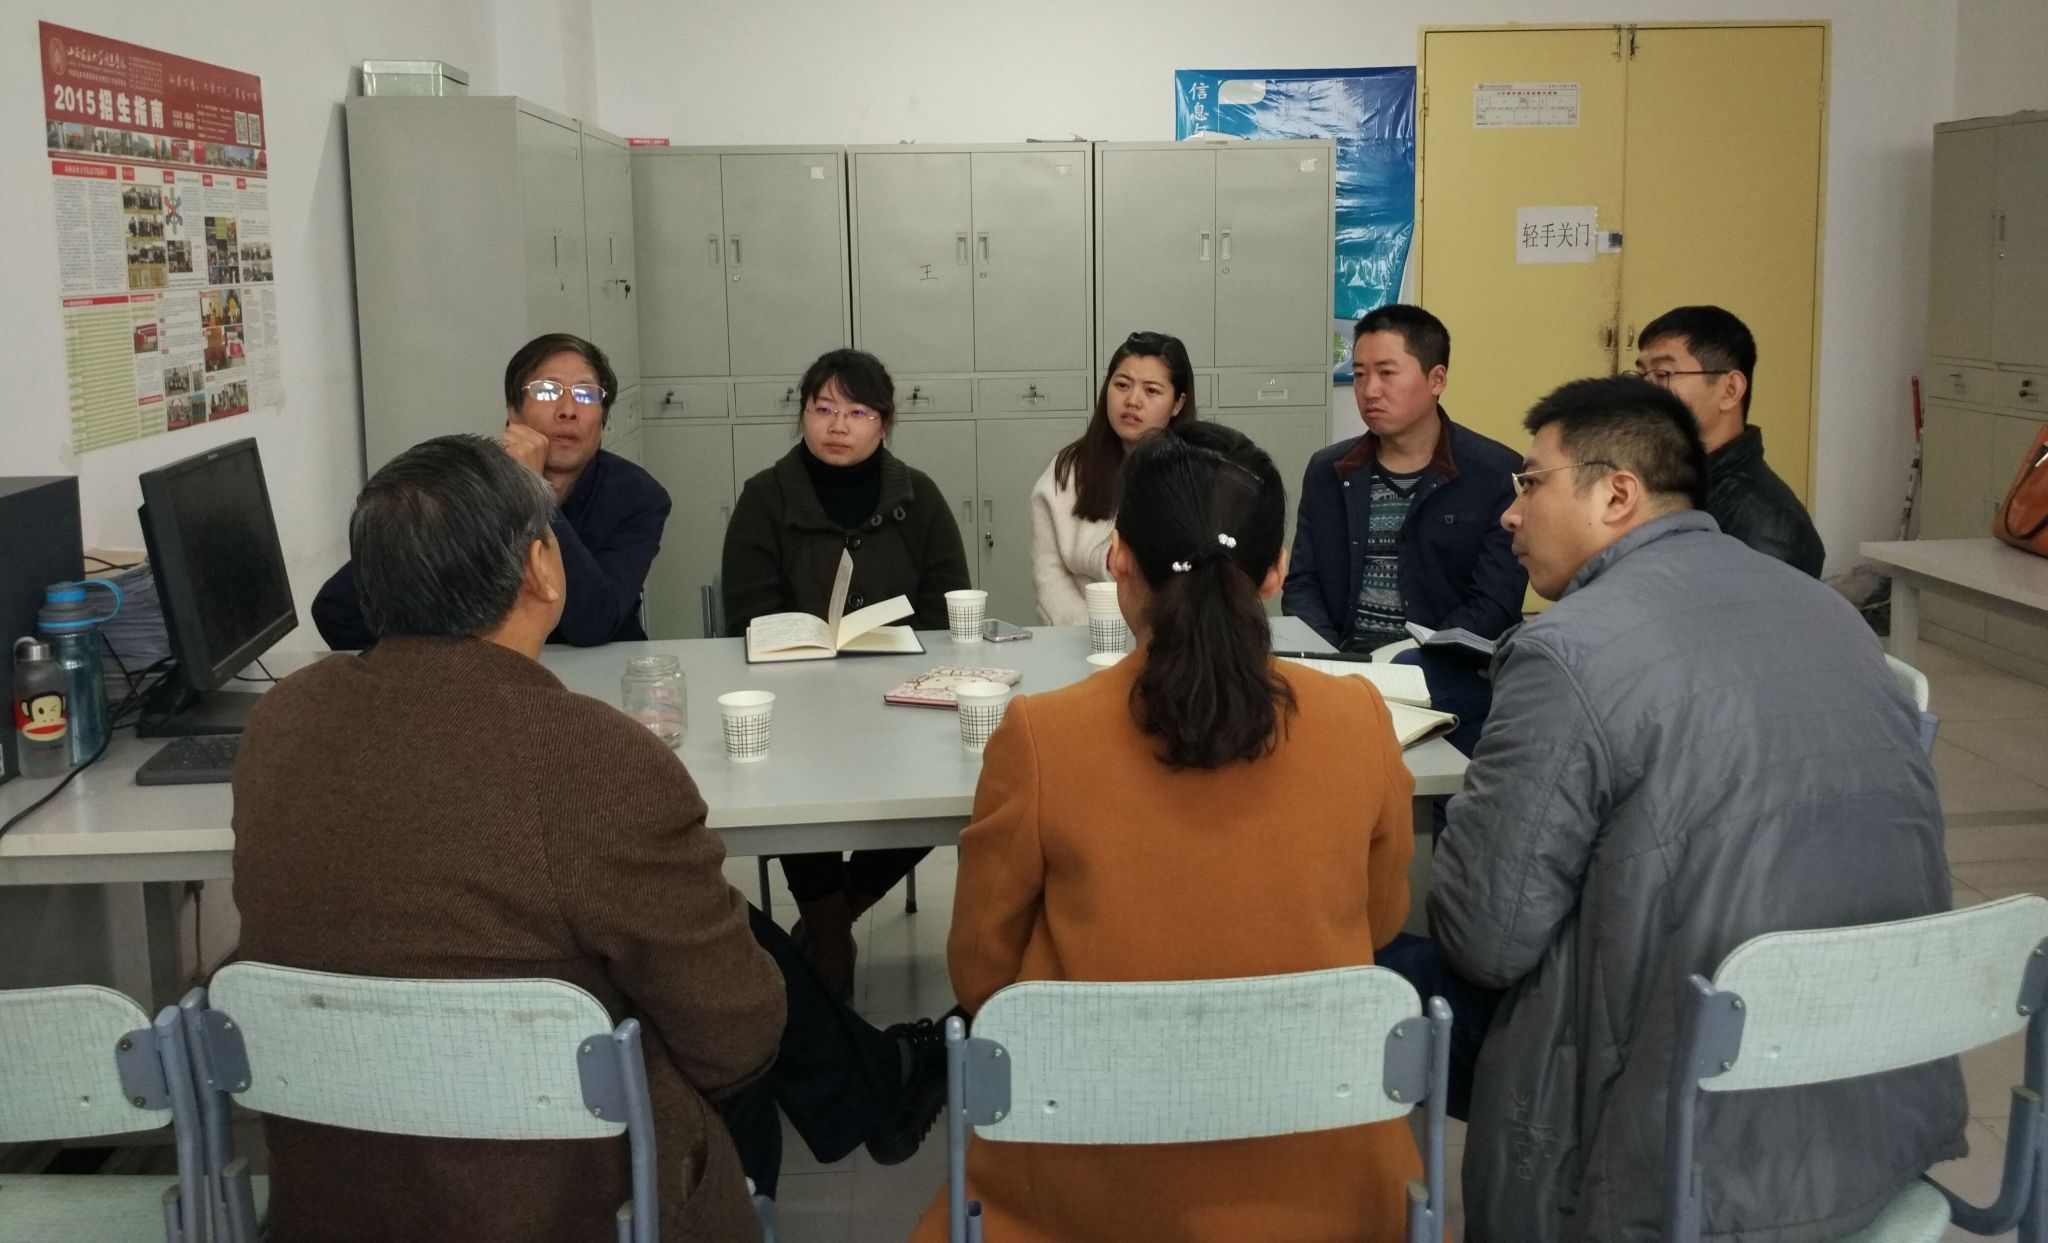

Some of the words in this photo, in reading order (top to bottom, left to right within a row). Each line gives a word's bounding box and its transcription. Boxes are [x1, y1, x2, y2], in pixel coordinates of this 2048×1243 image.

[54, 84, 164, 129] 2015招生指南
[1522, 222, 1590, 249] 轻手关门
[919, 264, 939, 282] 王
